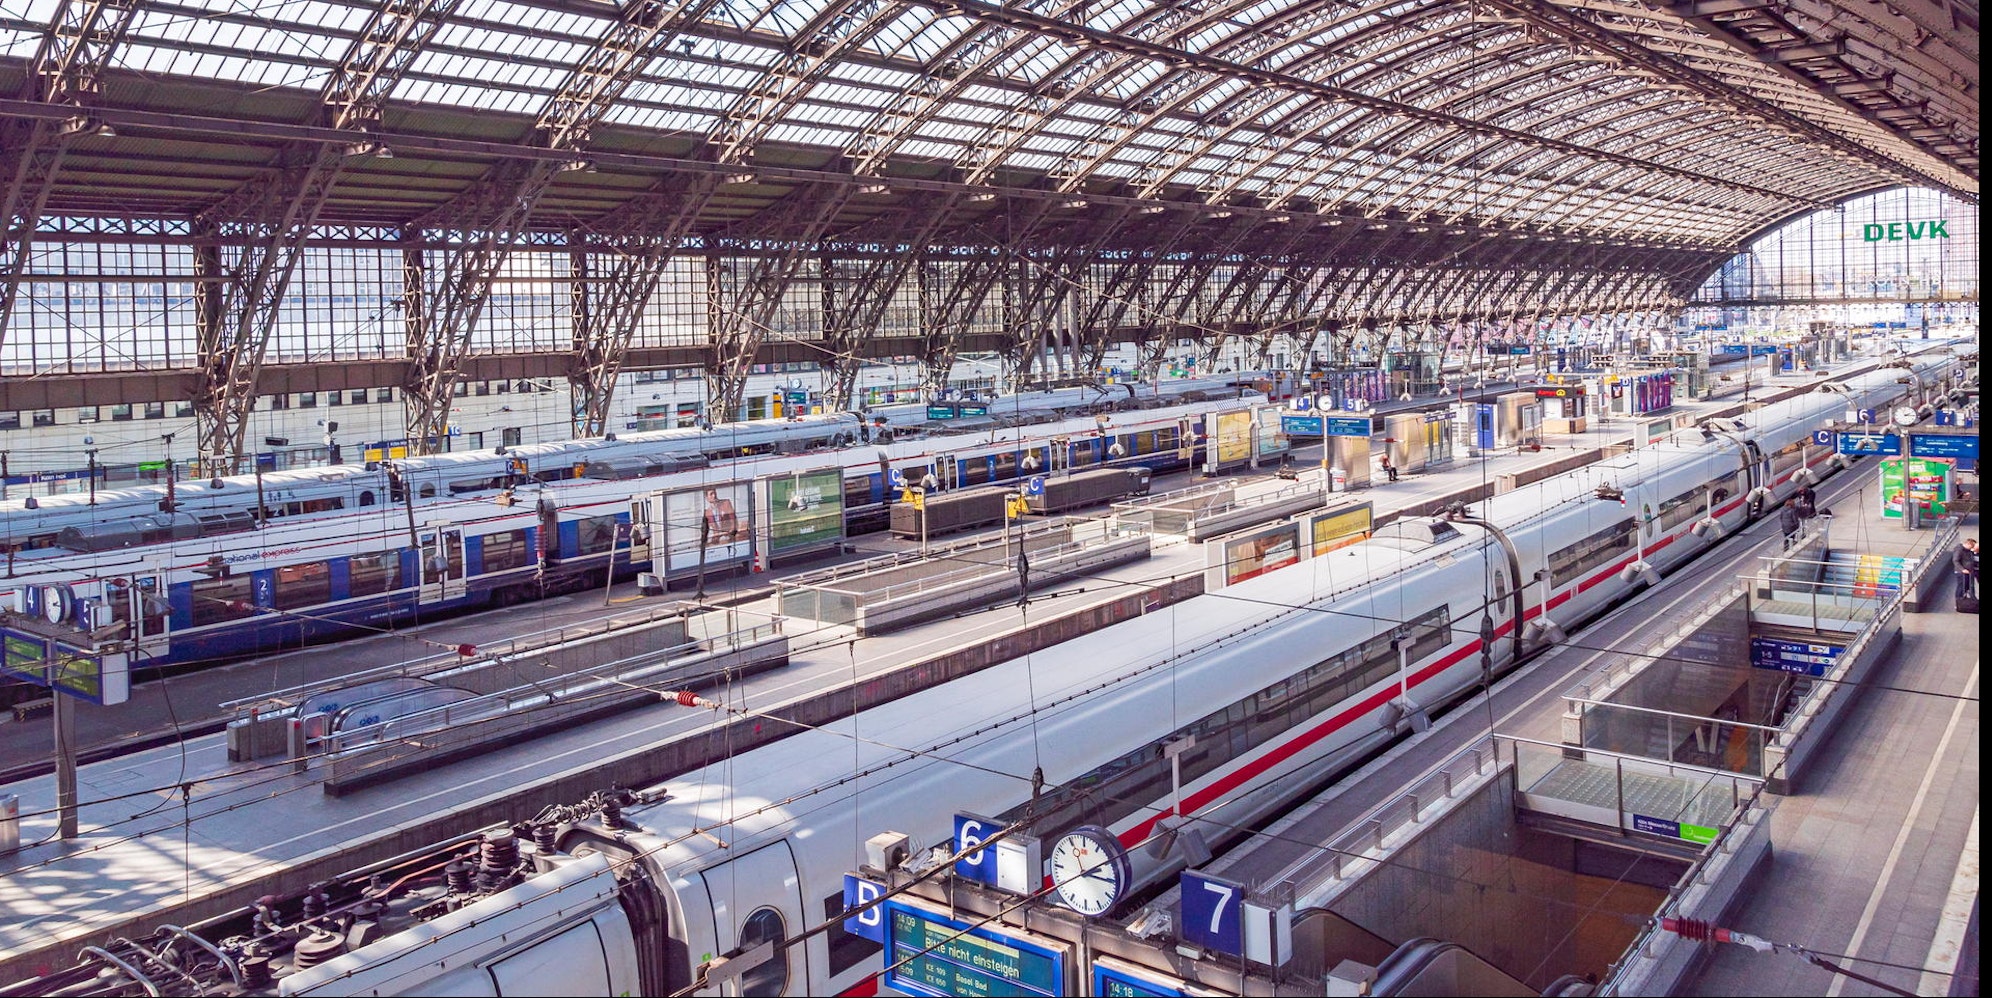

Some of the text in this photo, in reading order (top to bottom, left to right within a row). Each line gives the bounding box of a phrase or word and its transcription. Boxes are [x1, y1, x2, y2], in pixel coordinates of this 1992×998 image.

[1863, 220, 1949, 242] DEVK
[1347, 401, 1354, 409] 5
[1859, 410, 1869, 420] 6
[1818, 431, 1829, 443] C
[892, 469, 899, 481] C
[1030, 477, 1038, 491] C
[261, 546, 301, 559] express
[260, 579, 267, 591] 2
[27, 586, 34, 609] 4
[960, 820, 984, 866] 6
[858, 880, 881, 927] B
[1203, 881, 1233, 935] 7
[925, 936, 946, 954] Bitte
[948, 945, 970, 963] nicht
[973, 953, 1020, 980] einsteigen
[974, 979, 988, 992] Bad
[1110, 982, 1133, 997] 14:18
